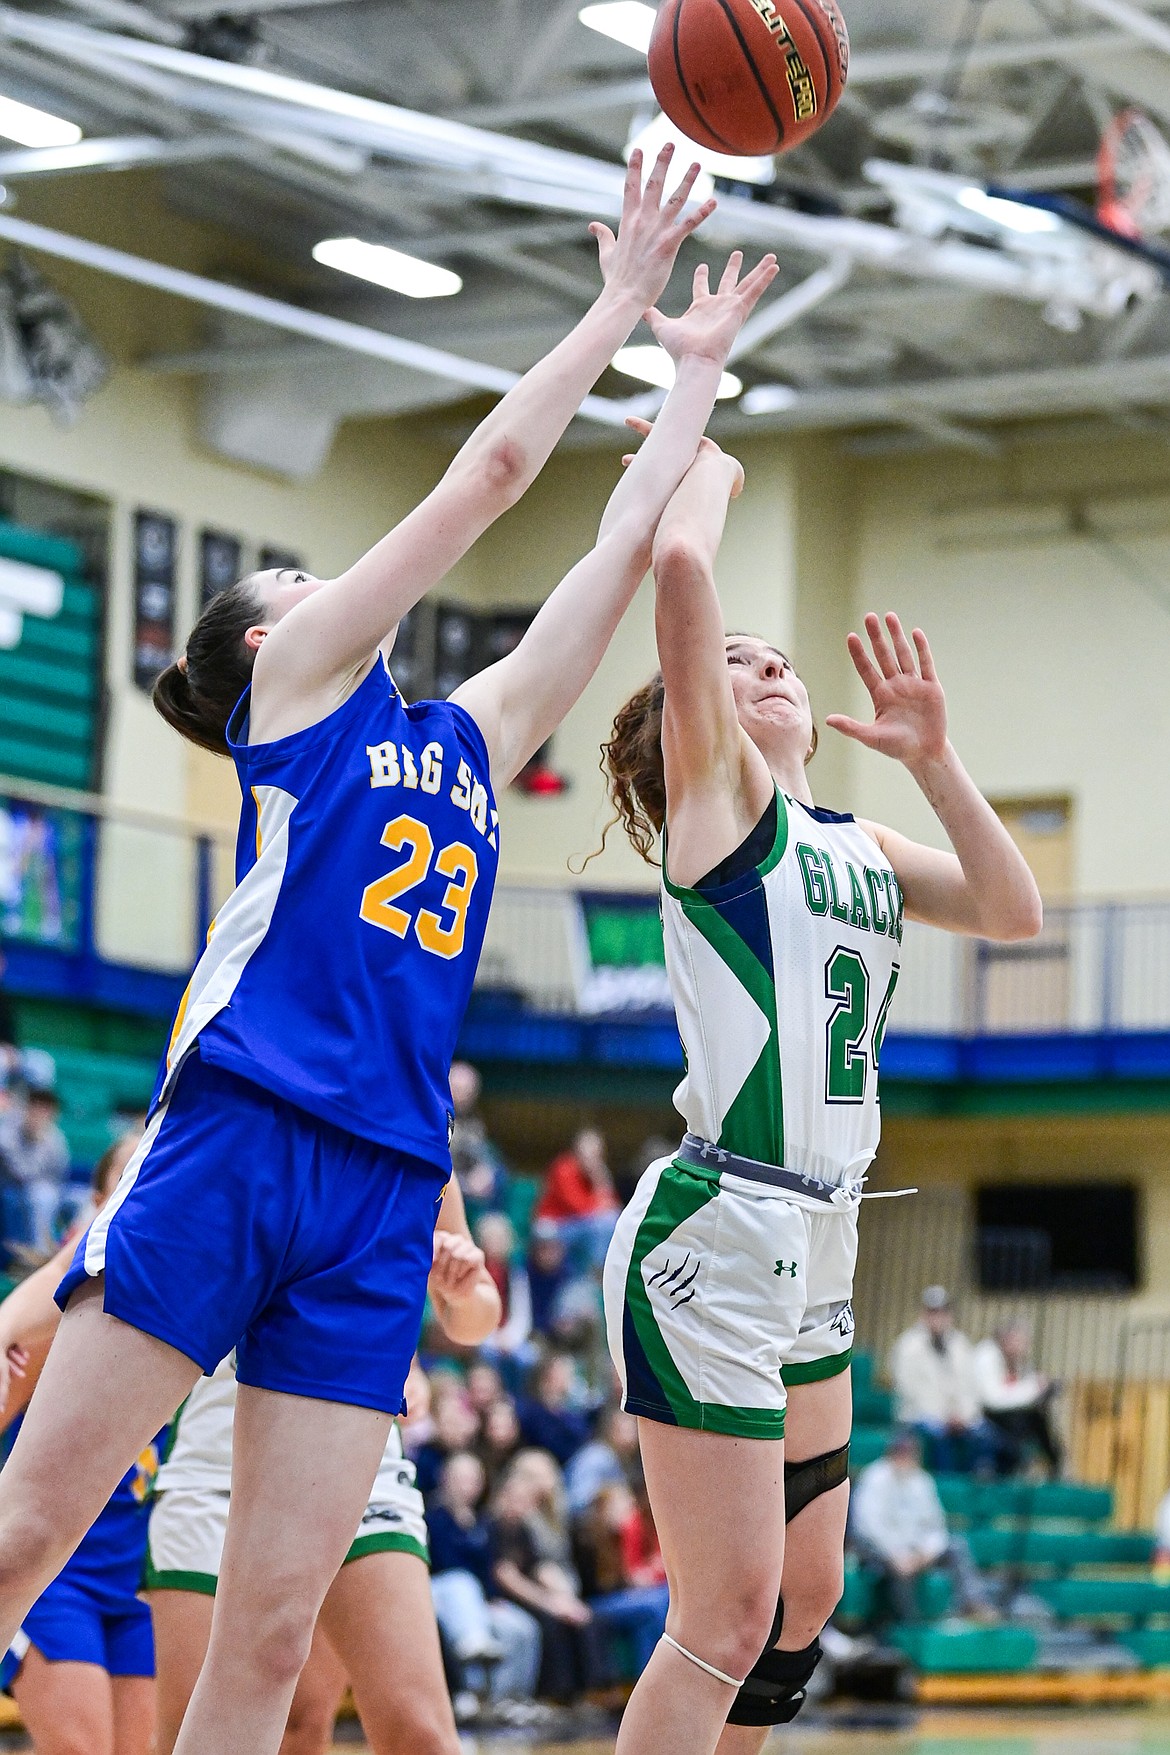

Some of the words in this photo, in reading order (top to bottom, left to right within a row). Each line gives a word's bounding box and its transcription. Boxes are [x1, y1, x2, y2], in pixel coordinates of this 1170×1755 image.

[791, 75, 815, 119] PRO
[366, 740, 443, 795] BIG
[359, 813, 479, 960] 23
